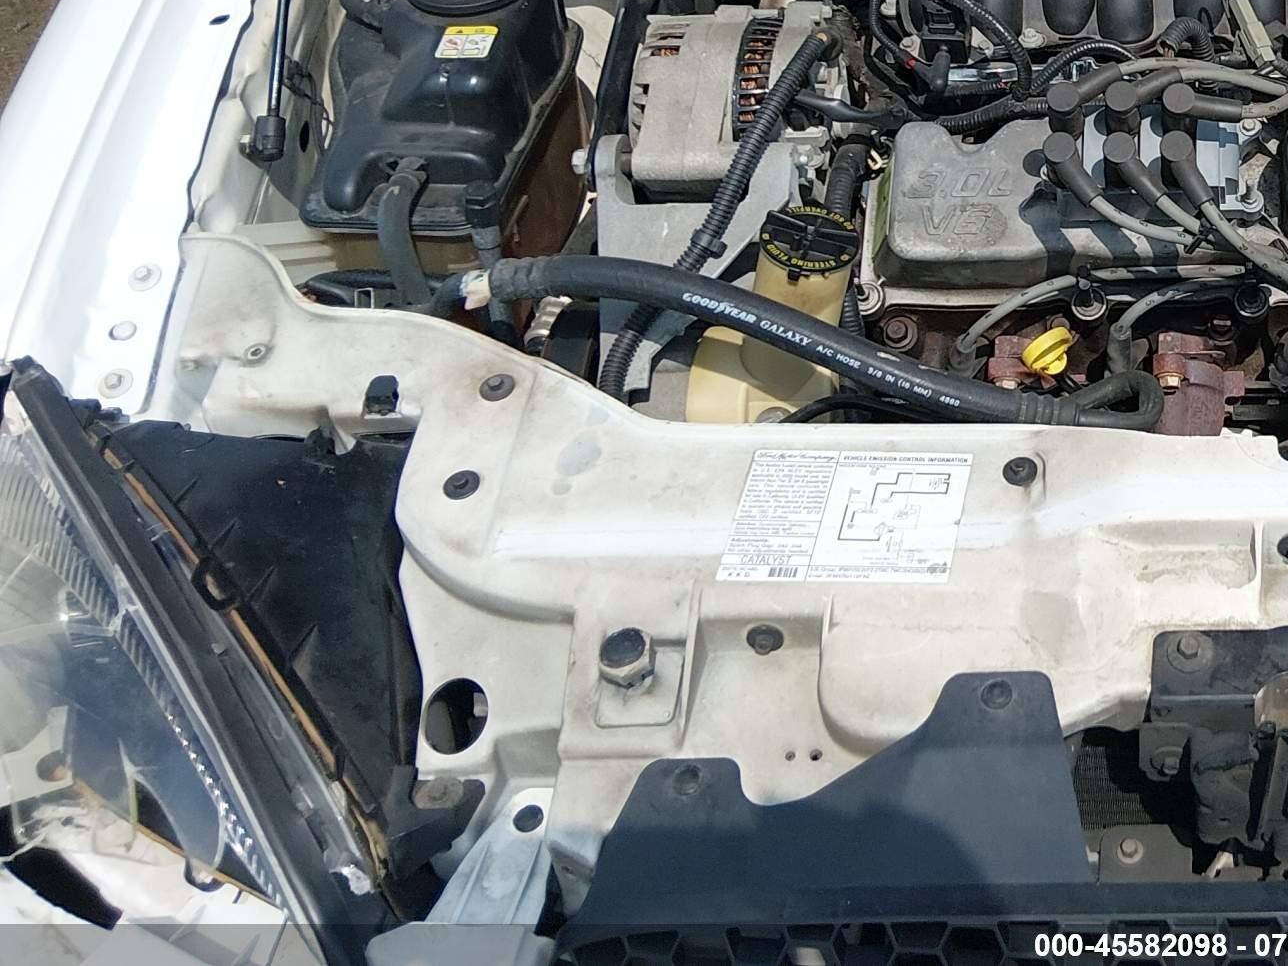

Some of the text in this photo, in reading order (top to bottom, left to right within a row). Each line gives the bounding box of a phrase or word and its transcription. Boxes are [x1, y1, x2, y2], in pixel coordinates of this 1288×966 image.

[903, 168, 1012, 199] 3.0L
[921, 202, 993, 236] V6
[790, 259, 837, 269] STEERING
[682, 292, 757, 324] GOODYEAR
[760, 320, 813, 347] GALAXY
[815, 344, 835, 358] A/C
[836, 352, 862, 370] HOSE
[740, 554, 793, 566] CATALYST
